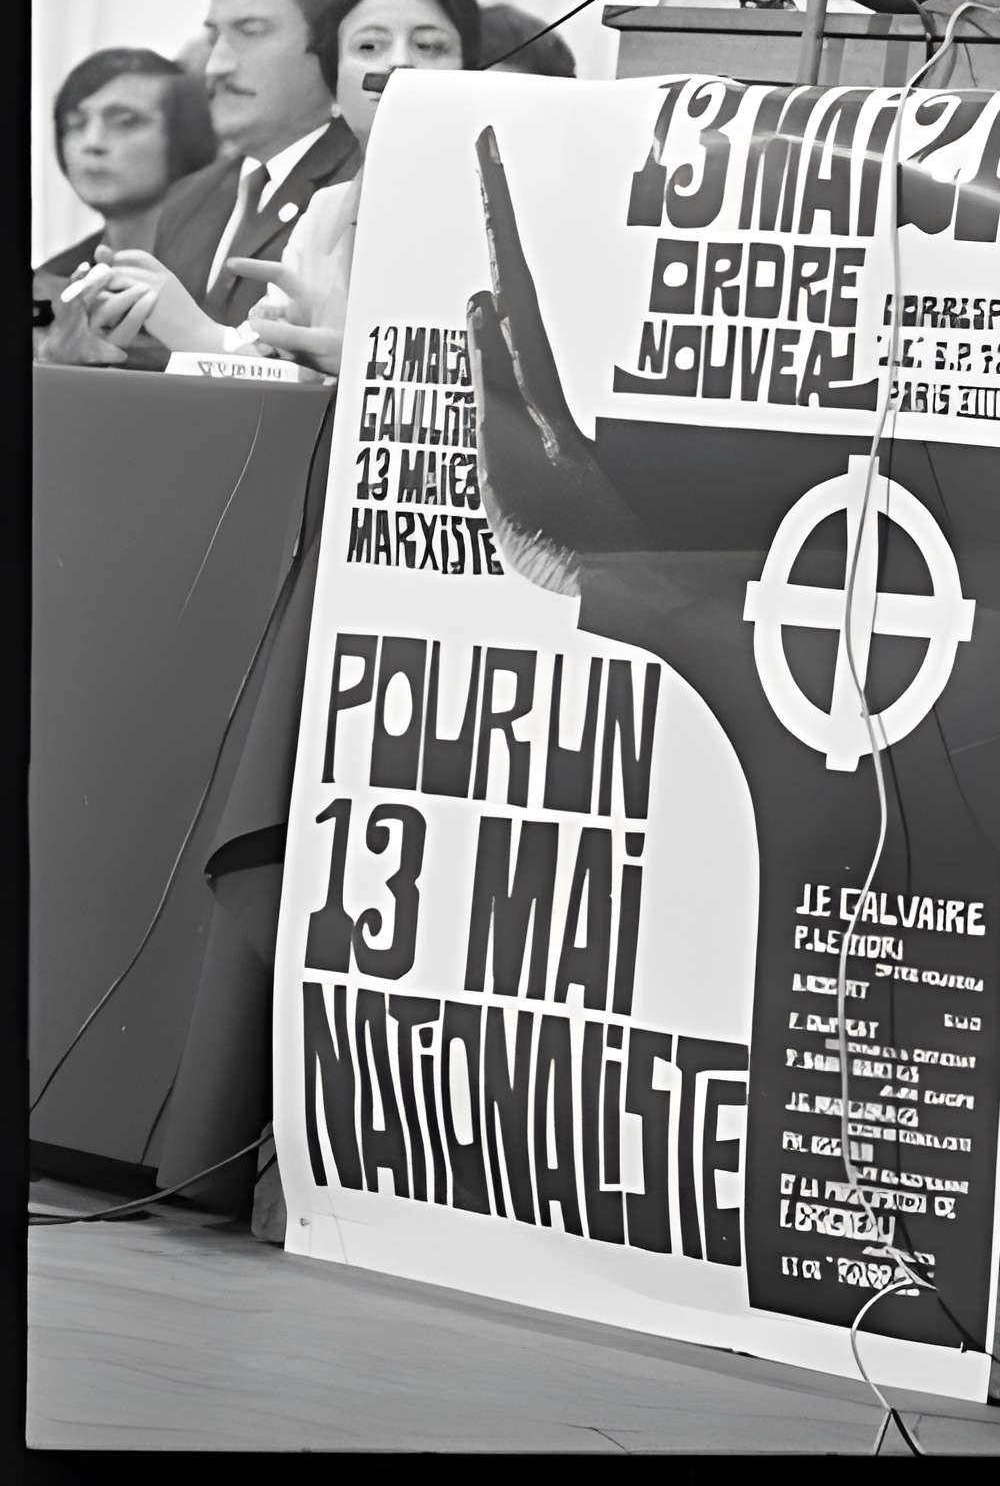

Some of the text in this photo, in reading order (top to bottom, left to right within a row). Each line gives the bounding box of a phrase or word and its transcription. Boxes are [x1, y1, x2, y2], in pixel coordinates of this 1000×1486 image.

[626, 78, 747, 229] 13
[649, 237, 866, 327] ORDRE
[366, 326, 398, 381] 13
[356, 447, 390, 501] 13
[322, 632, 661, 820] POUR UN
[304, 798, 427, 980] 13
